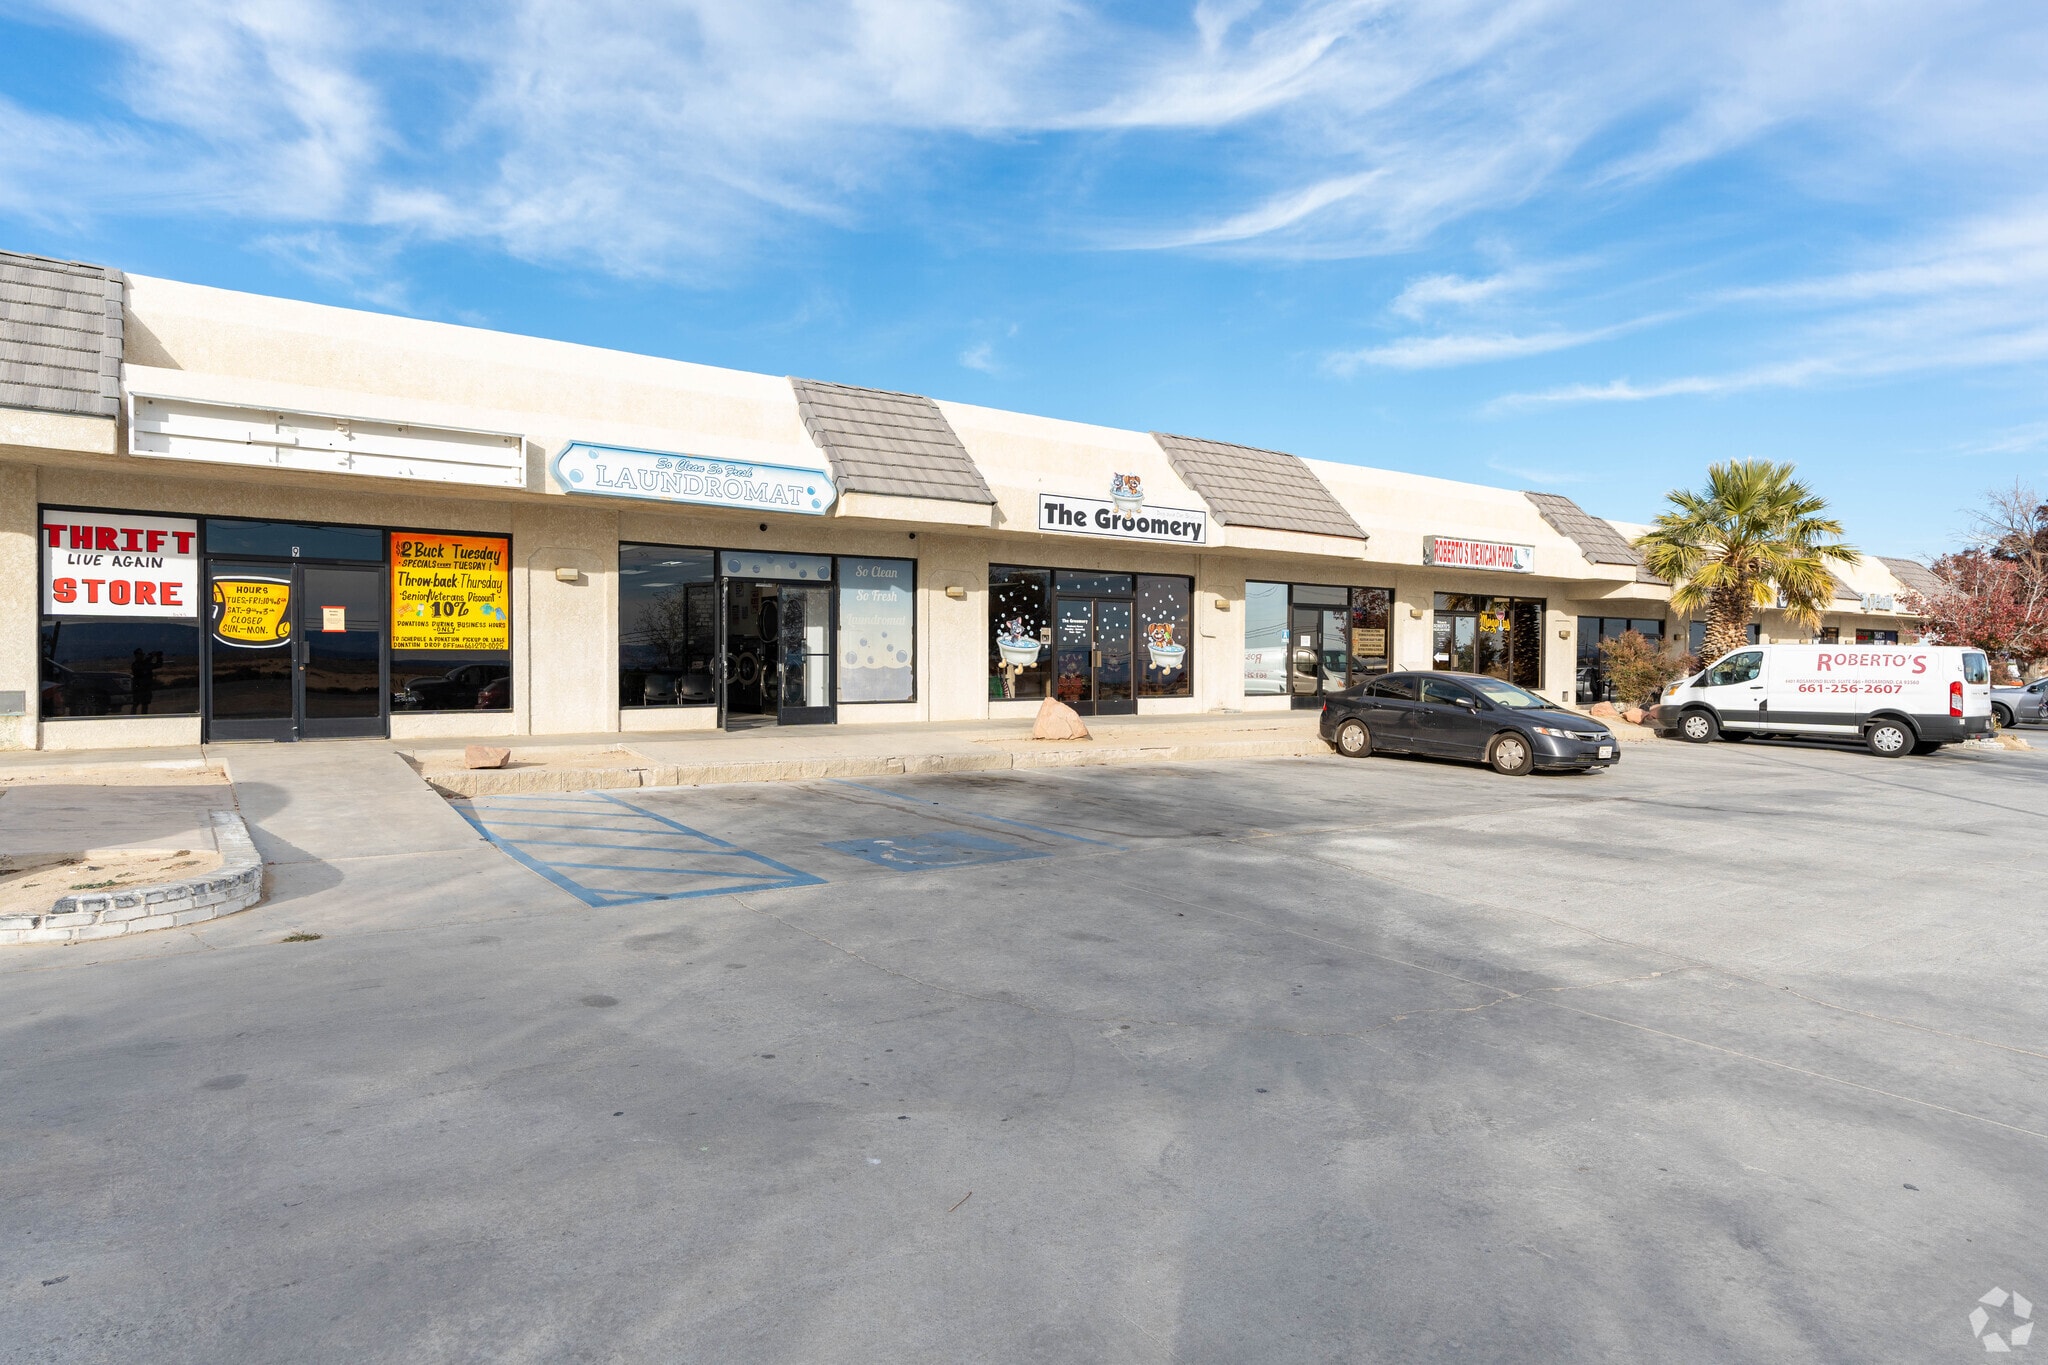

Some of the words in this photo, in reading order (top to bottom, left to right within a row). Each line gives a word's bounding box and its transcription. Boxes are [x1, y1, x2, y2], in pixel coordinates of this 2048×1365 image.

[656, 458, 672, 469] So
[675, 459, 705, 472] Clean
[707, 464, 723, 474] So
[725, 465, 753, 478] Fresh
[596, 464, 804, 505] LAUNDROMAT
[1044, 503, 1087, 527] The
[1095, 508, 1202, 541] Groomery
[43, 523, 196, 554] THRIFT
[292, 547, 299, 557] 9
[414, 541, 444, 558] Buck
[452, 544, 501, 566] Tuesday
[1434, 539, 1469, 564] ROBERTO'S
[1470, 542, 1497, 567] MEXICAN
[1498, 545, 1513, 567] FOOD
[67, 553, 103, 566] LIVE
[112, 555, 164, 568] AGAIN
[402, 559, 436, 568] SPECIALS
[856, 565, 869, 577] So
[871, 565, 898, 578] Clean
[236, 586, 269, 594] HOURS
[461, 573, 502, 593] Thursday
[53, 577, 183, 606] STORE
[468, 592, 496, 602] Discount
[856, 589, 869, 602] So
[871, 590, 898, 602] Fresh
[430, 602, 469, 618] 10%
[231, 616, 263, 624] CLOSED
[1817, 653, 1926, 674] ROBERTO'S
[1798, 684, 1903, 694] 661-256-2607
